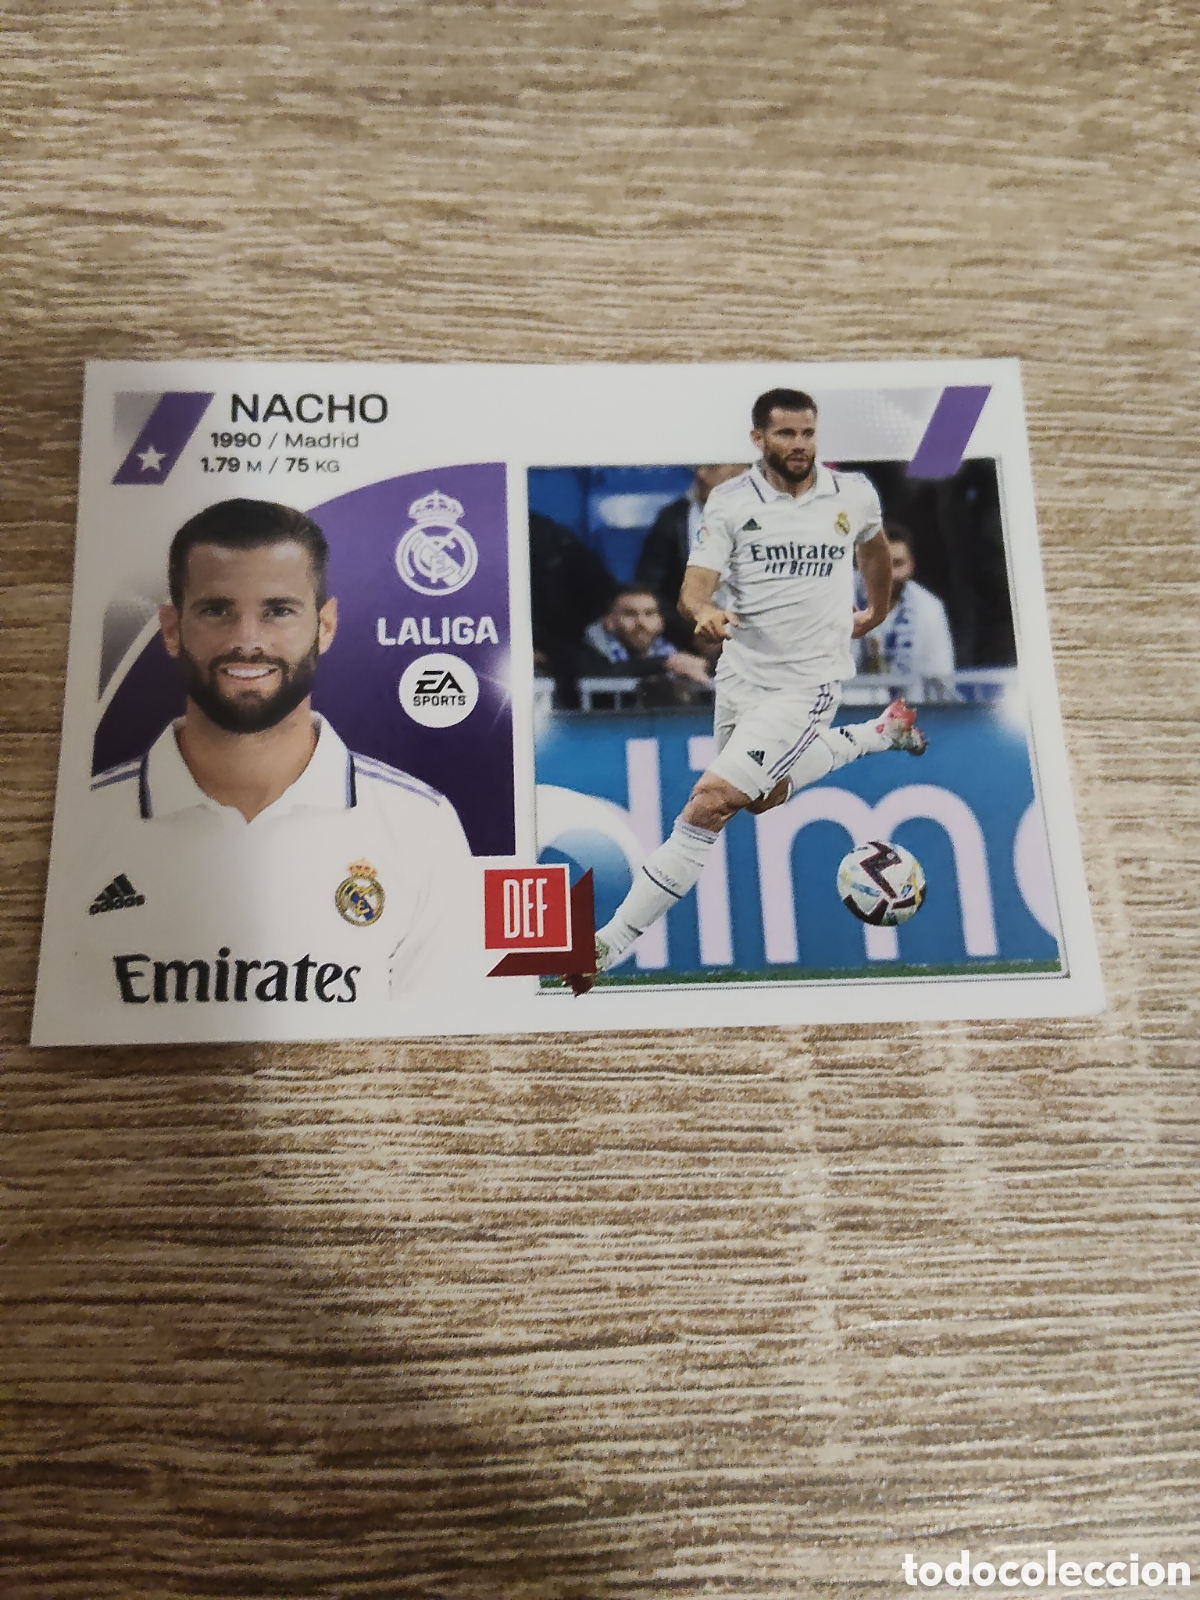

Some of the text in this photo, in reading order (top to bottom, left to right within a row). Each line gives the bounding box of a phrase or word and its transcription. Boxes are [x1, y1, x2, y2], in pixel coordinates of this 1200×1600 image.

[230, 392, 389, 424] NACHO
[210, 431, 262, 448] 1990
[285, 432, 360, 449] Madrid
[200, 456, 241, 474] 1.79
[246, 461, 262, 474] M
[285, 457, 310, 474] 75
[315, 459, 341, 474] KG
[750, 541, 846, 562] Emirates
[788, 559, 834, 578] BETTER
[376, 615, 500, 647] LALIGA
[414, 670, 465, 695] EA
[412, 695, 467, 707] SPORTS
[502, 877, 549, 939] DEF
[112, 945, 362, 1004] Emirates
